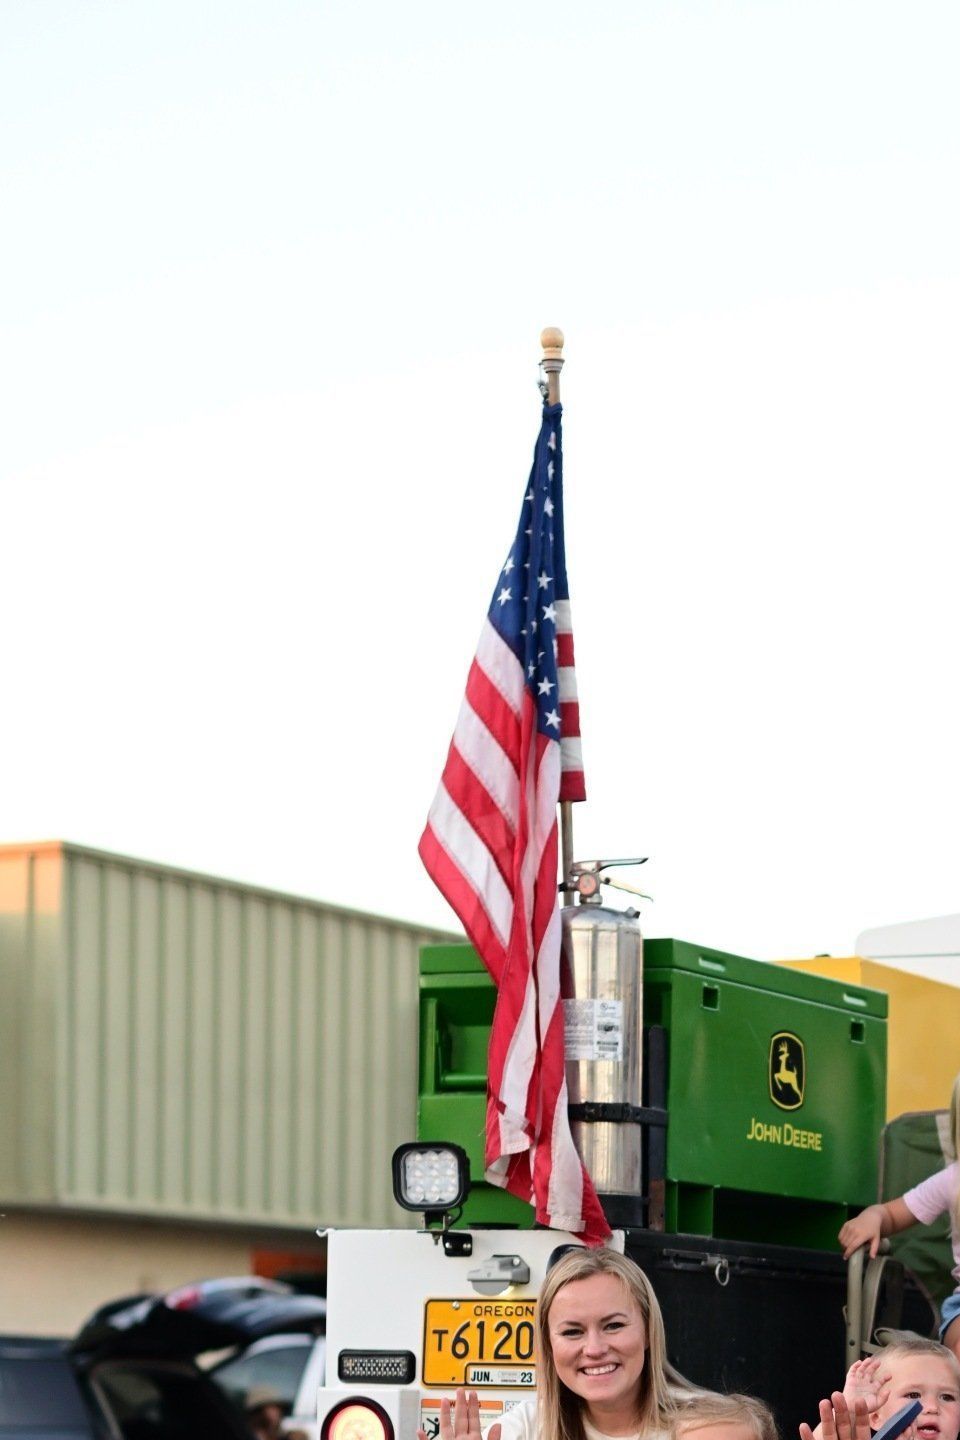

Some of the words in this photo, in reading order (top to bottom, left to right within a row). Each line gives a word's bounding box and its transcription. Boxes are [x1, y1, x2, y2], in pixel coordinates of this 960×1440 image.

[783, 1123, 822, 1151] DEERE
[473, 1305, 535, 1317] OREGON
[520, 1371, 533, 1383] 23
